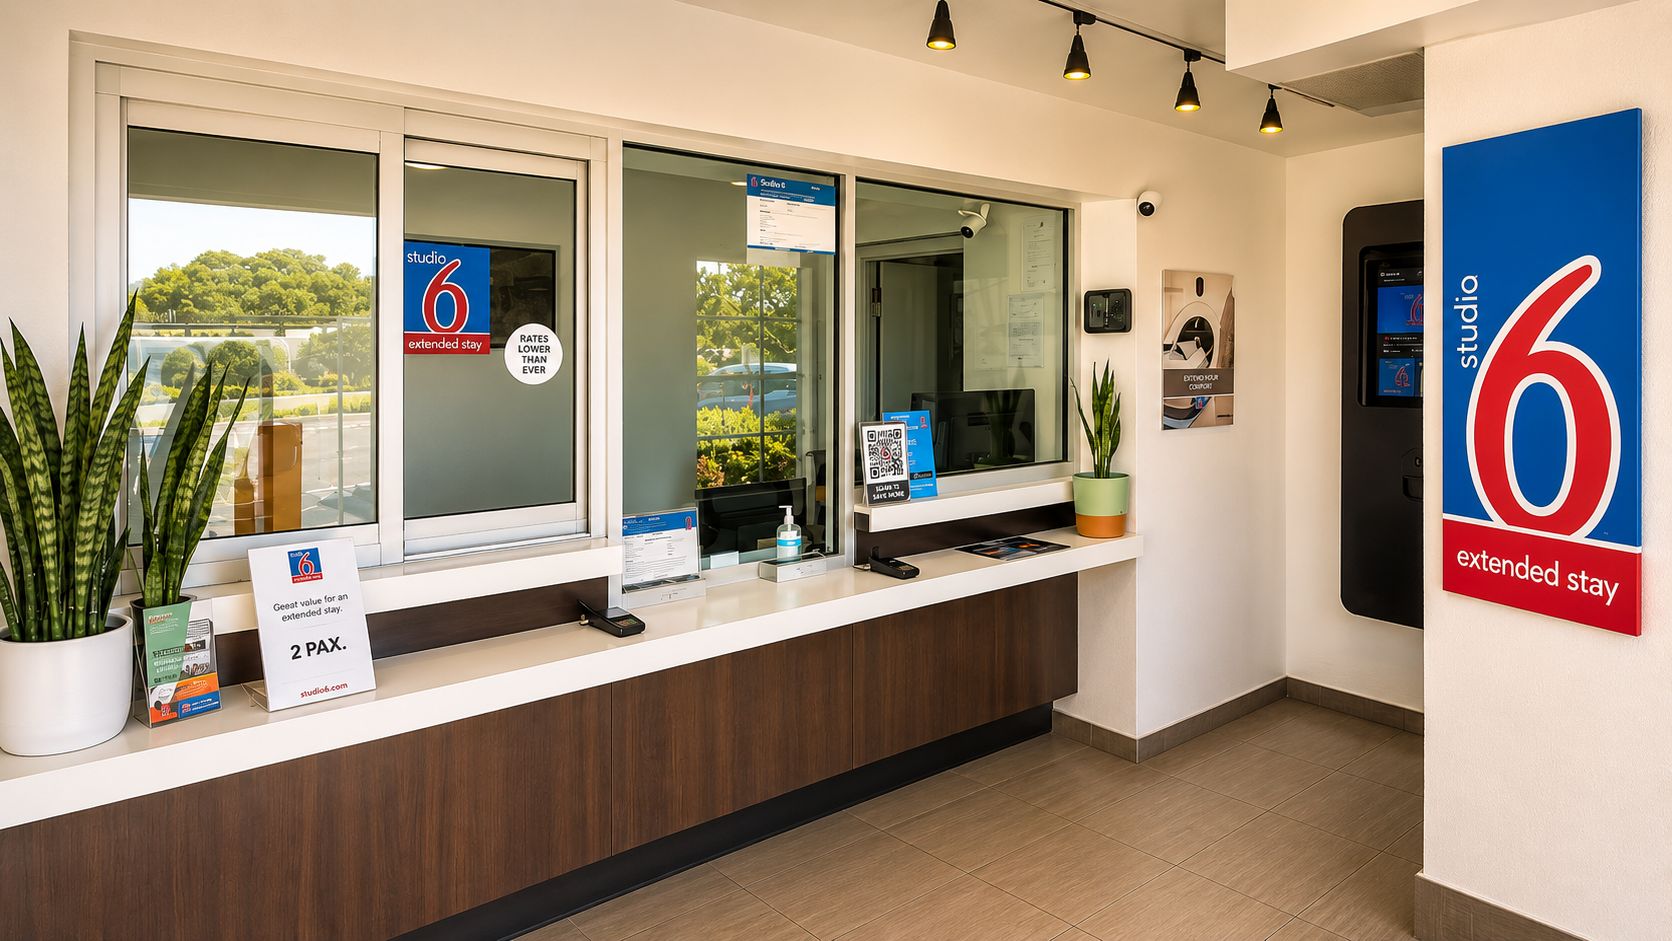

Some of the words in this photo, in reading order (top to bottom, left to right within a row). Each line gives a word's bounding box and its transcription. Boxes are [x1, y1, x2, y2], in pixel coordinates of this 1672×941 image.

[407, 250, 447, 265] studio
[421, 258, 470, 334] 6
[408, 336, 459, 350] extended
[461, 338, 483, 352] stay
[519, 334, 549, 343] RATES
[518, 344, 551, 353] LOWER
[521, 355, 548, 364] THAN
[522, 365, 546, 374] EVER
[1465, 254, 1622, 540] 6
[298, 551, 315, 577] 6
[1456, 549, 1560, 587] extended
[1567, 570, 1620, 606] stay
[300, 597, 322, 608] value
[324, 595, 337, 604] for
[337, 593, 348, 601] an
[281, 608, 322, 622] extended
[324, 605, 343, 616] stay.
[290, 644, 302, 660] 2
[305, 636, 347, 657] PAX.
[300, 682, 348, 698] studio6.com
